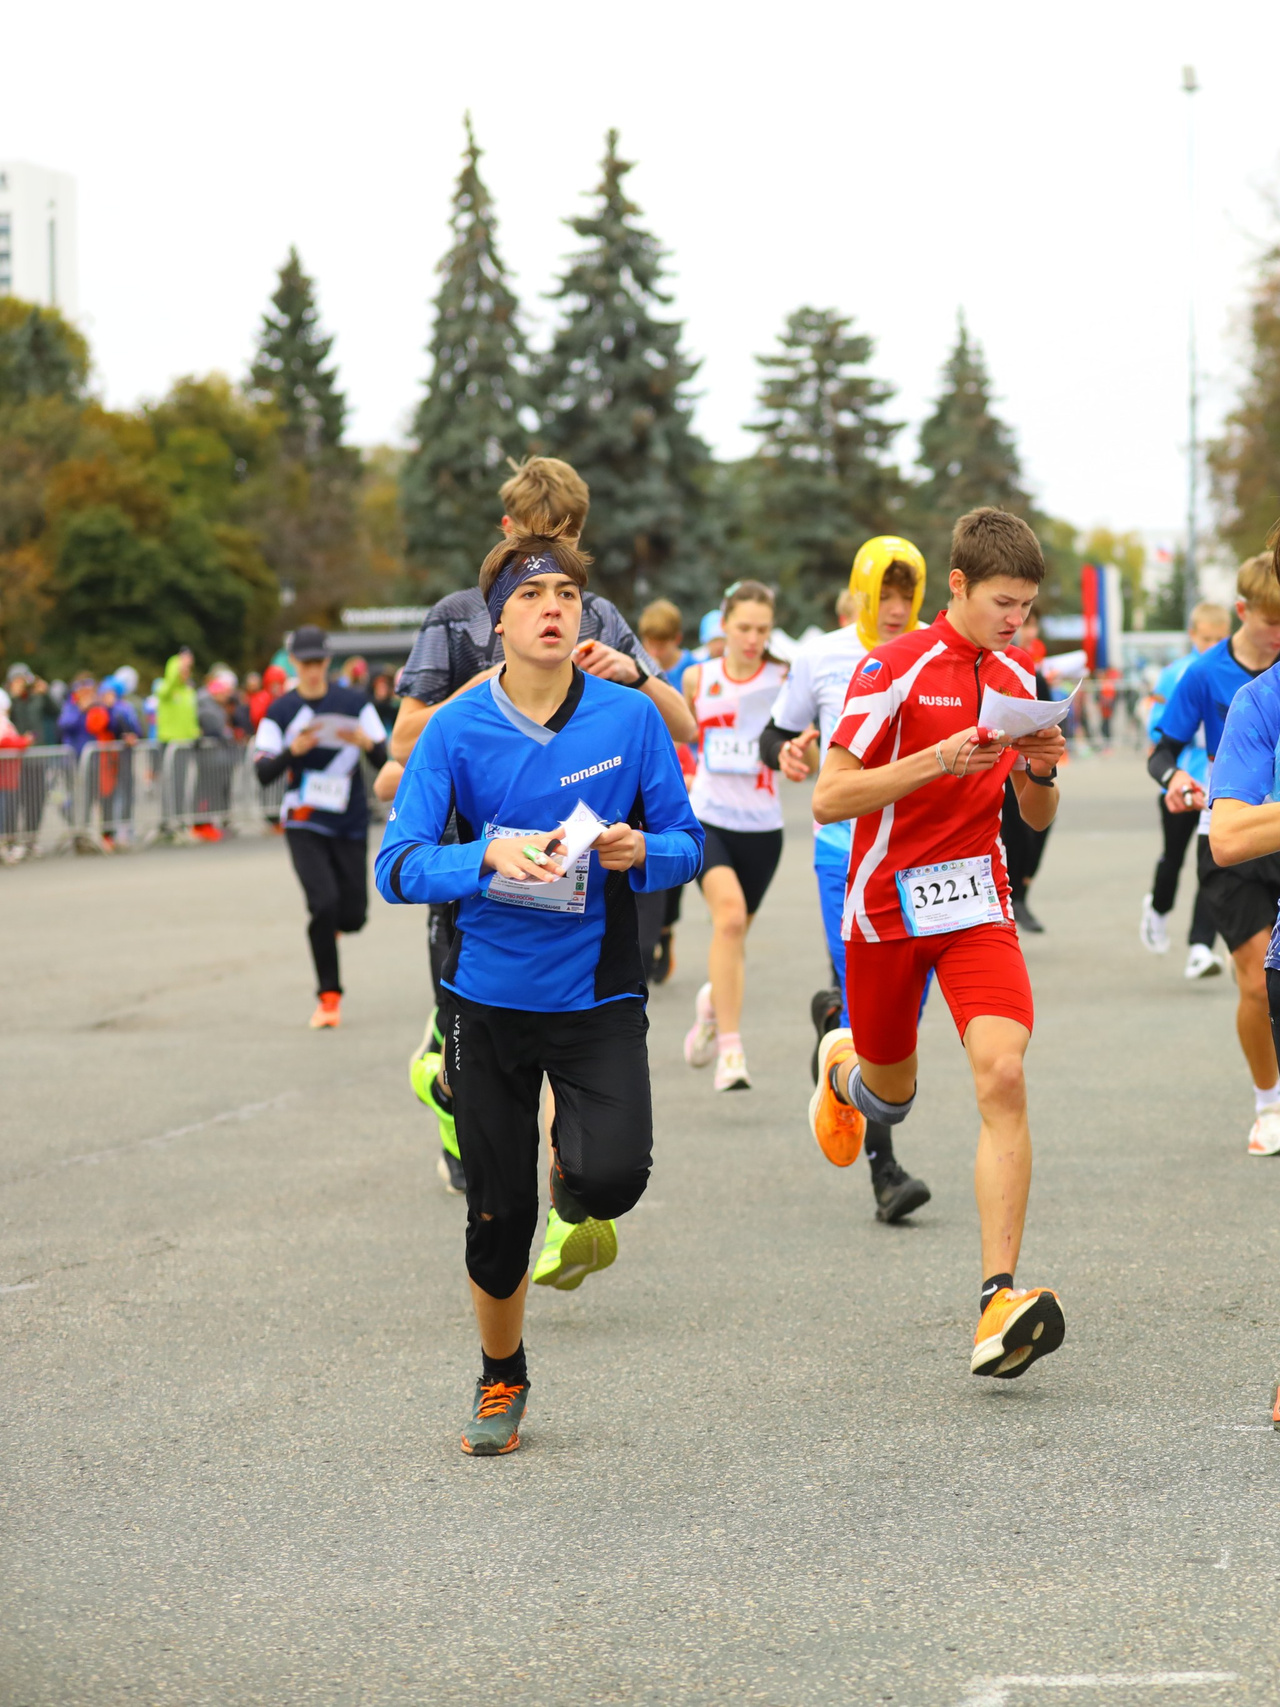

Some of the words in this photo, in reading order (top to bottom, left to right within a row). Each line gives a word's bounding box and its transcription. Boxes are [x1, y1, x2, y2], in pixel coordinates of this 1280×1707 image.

[918, 694, 962, 707] RUSSIA
[560, 755, 622, 787] noname
[912, 874, 981, 909] 322.1
